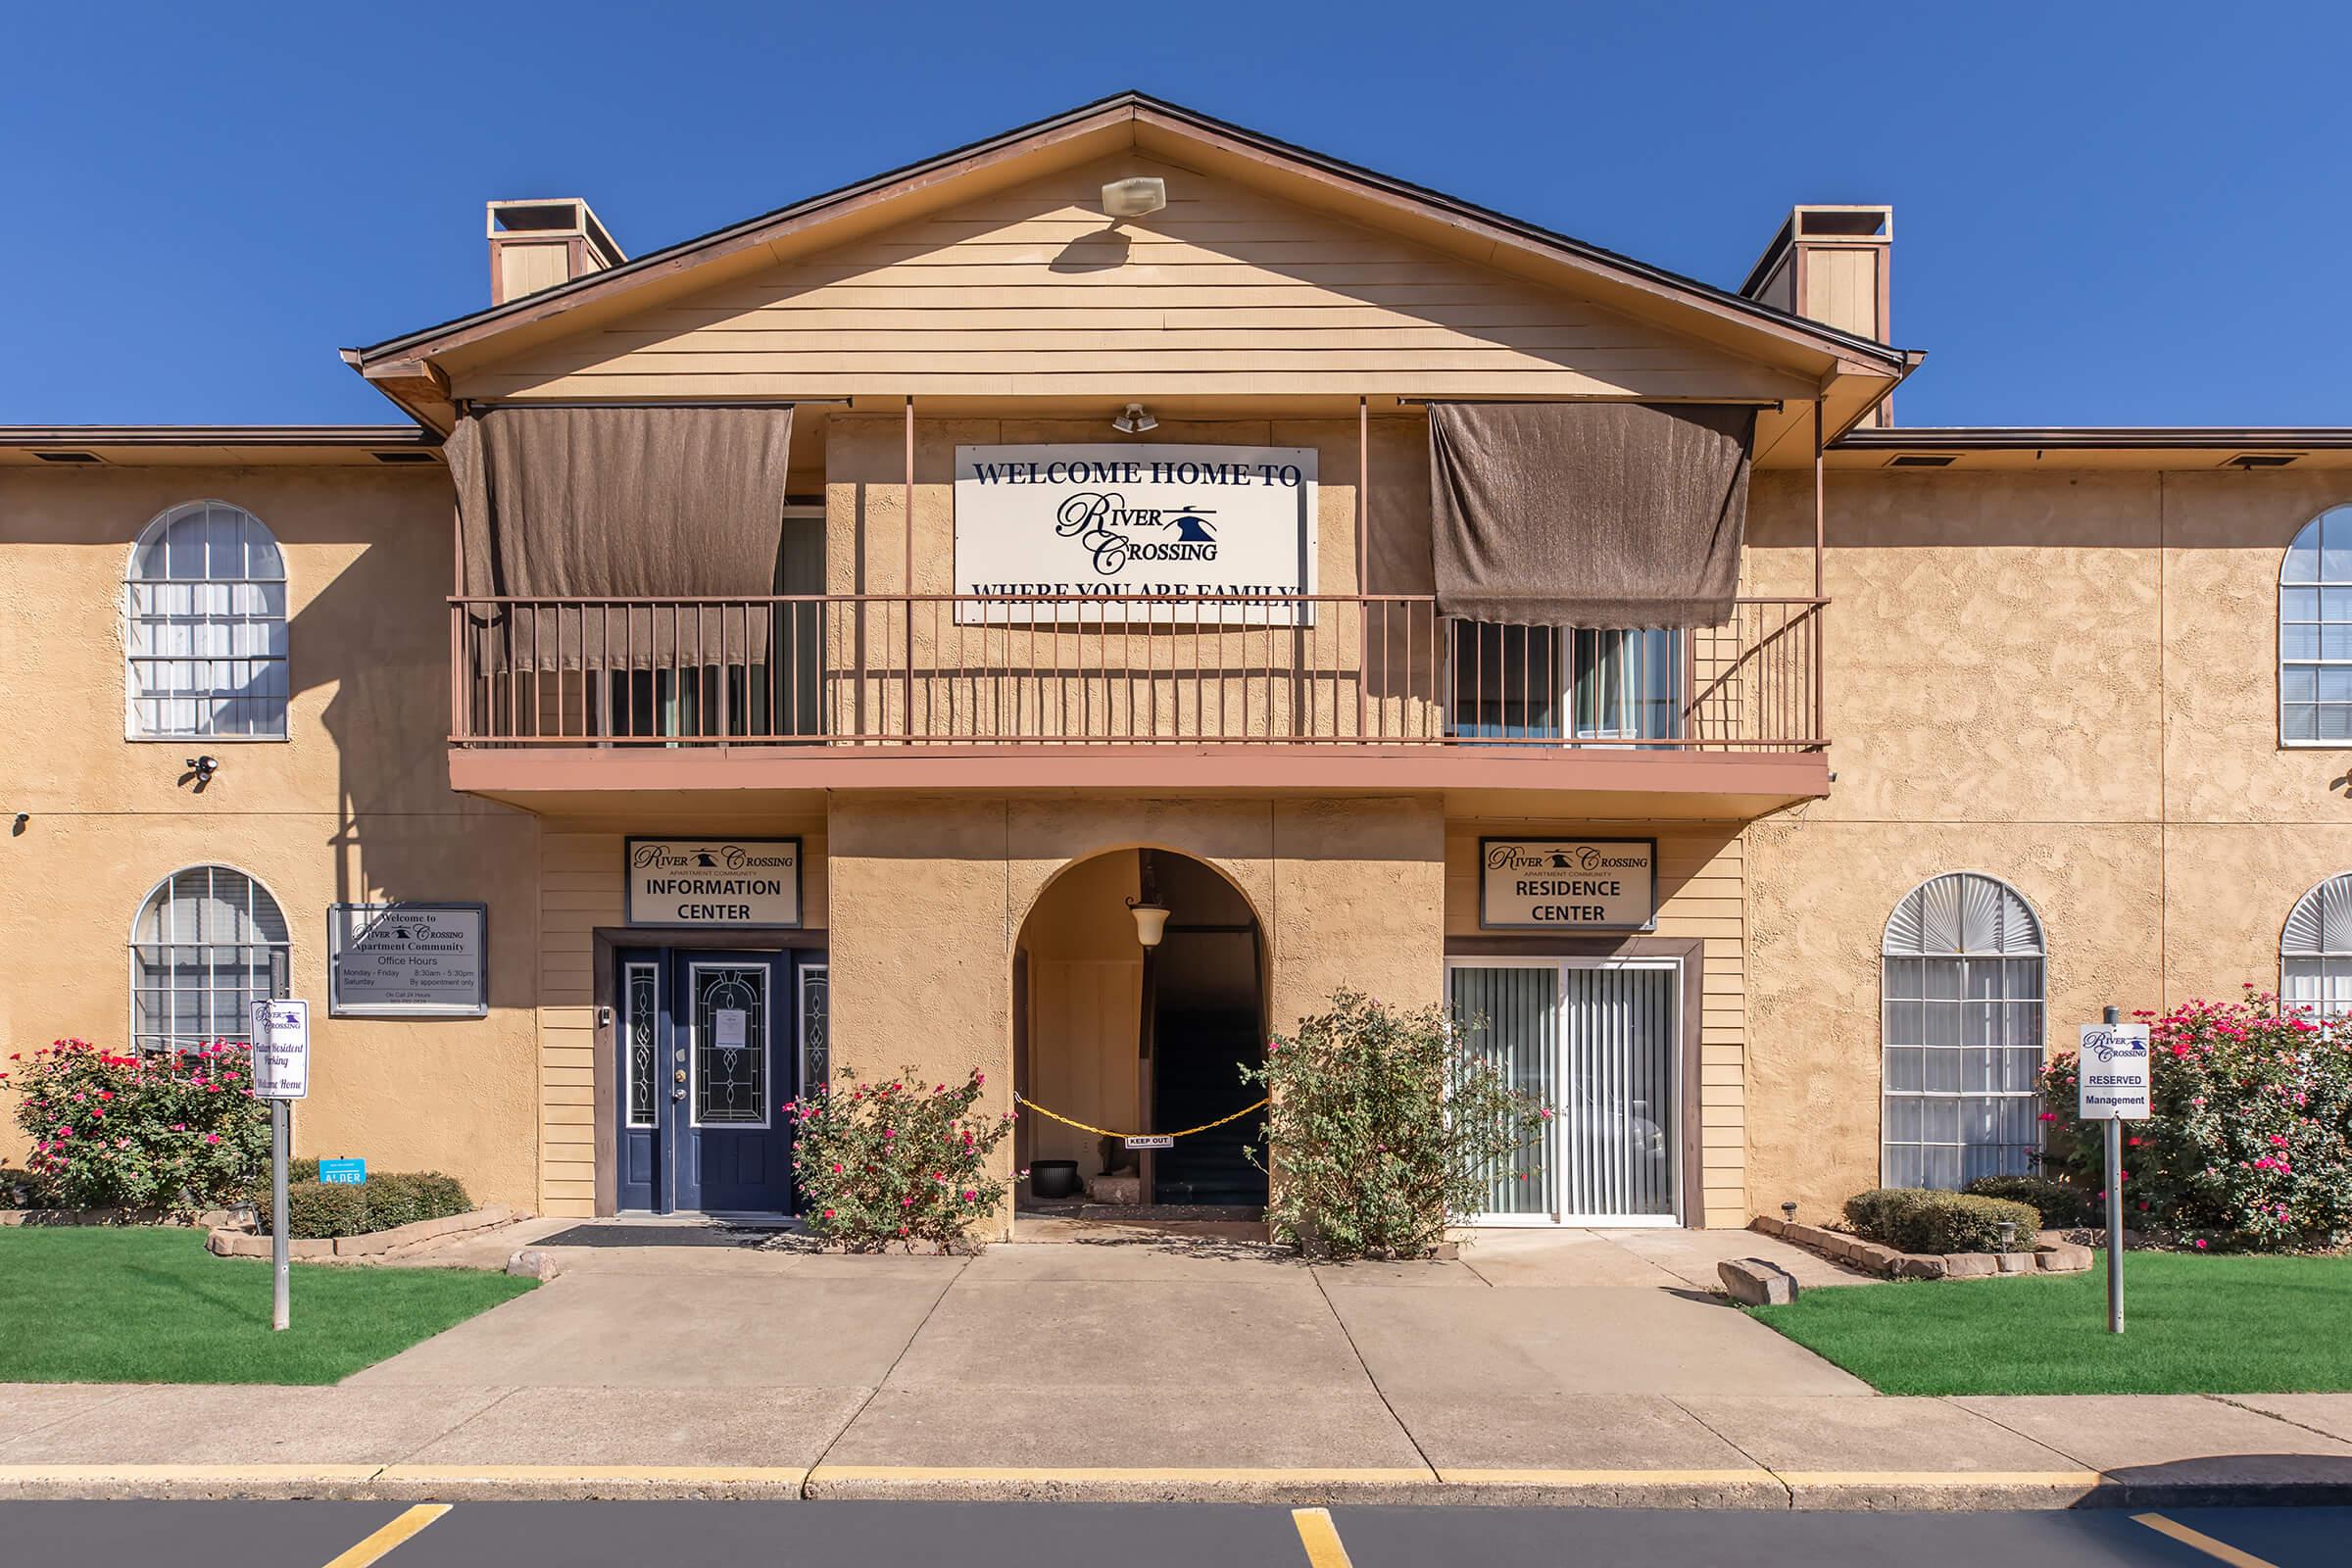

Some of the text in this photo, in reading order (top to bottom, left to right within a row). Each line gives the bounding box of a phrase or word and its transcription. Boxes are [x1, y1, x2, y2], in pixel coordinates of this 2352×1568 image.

[972, 462, 1301, 487] WELCOME HOME TO
[1055, 492, 1163, 538] RIVER
[1082, 530, 1218, 575] CROSSING
[972, 583, 1303, 607] WHERE YOU ARE FAMILY!
[634, 845, 793, 870] RIVER CROSSING
[1488, 846, 1647, 871] RIVER CROSSING
[647, 879, 780, 895] INFORMATION
[1516, 880, 1620, 896] RESIDENCE
[382, 913, 436, 923] Welcome to
[677, 905, 751, 919] CENTER
[1532, 906, 1605, 920] CENTER
[413, 923, 464, 941] CROSSING
[355, 942, 464, 953] Apartment Community
[378, 956, 438, 965] Office Hours
[343, 969, 371, 978] Monday
[377, 969, 400, 978] Friday
[343, 978, 374, 987] Saturday
[410, 978, 419, 987] By
[2082, 1031, 2126, 1049] RIVER
[2094, 1045, 2147, 1062] CROSSING
[280, 1078, 301, 1089] Home
[2089, 1076, 2141, 1085] RESERVED
[2085, 1096, 2144, 1106] Management
